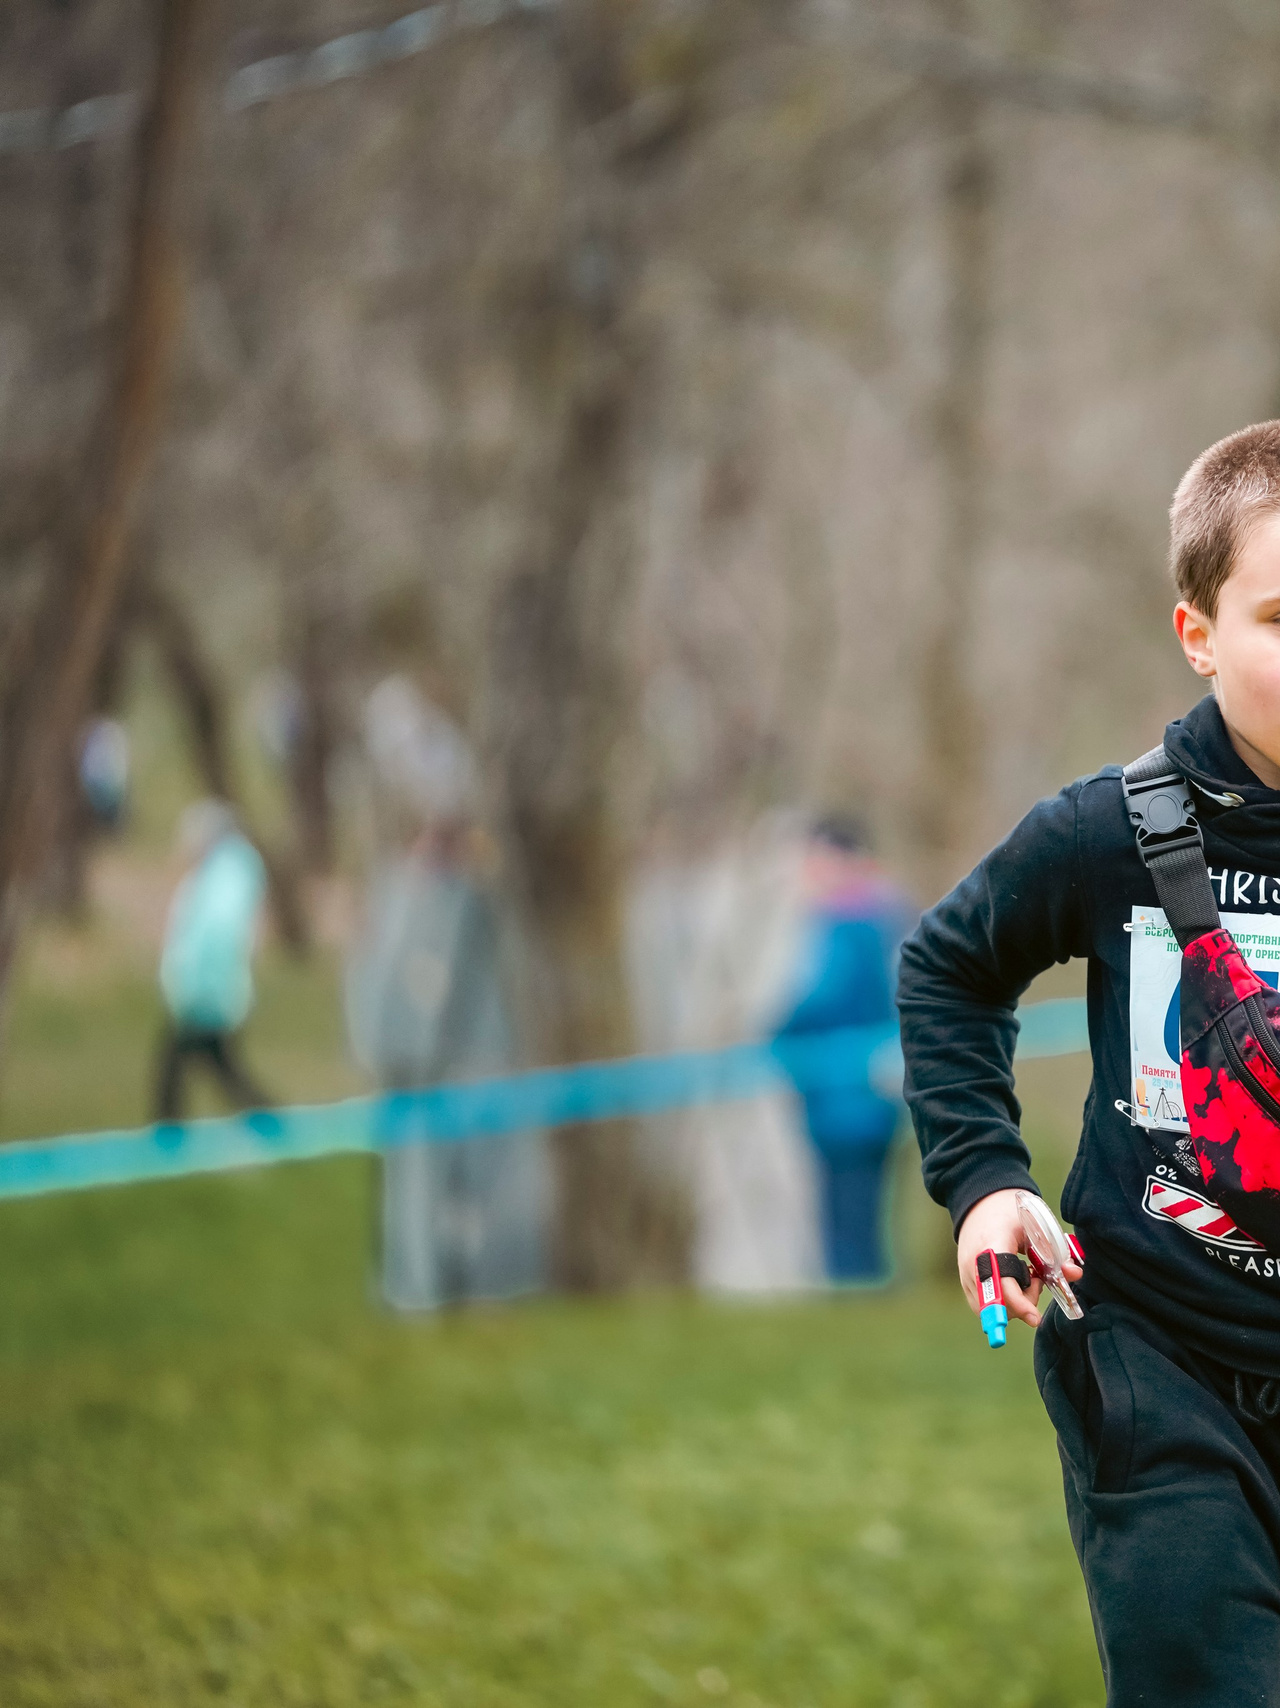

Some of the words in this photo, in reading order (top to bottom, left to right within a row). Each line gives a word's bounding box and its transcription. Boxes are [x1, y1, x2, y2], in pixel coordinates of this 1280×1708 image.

[1166, 942, 1179, 953] ПО
[1142, 1065, 1177, 1079] Памяти
[1155, 1165, 1178, 1181] 0%
